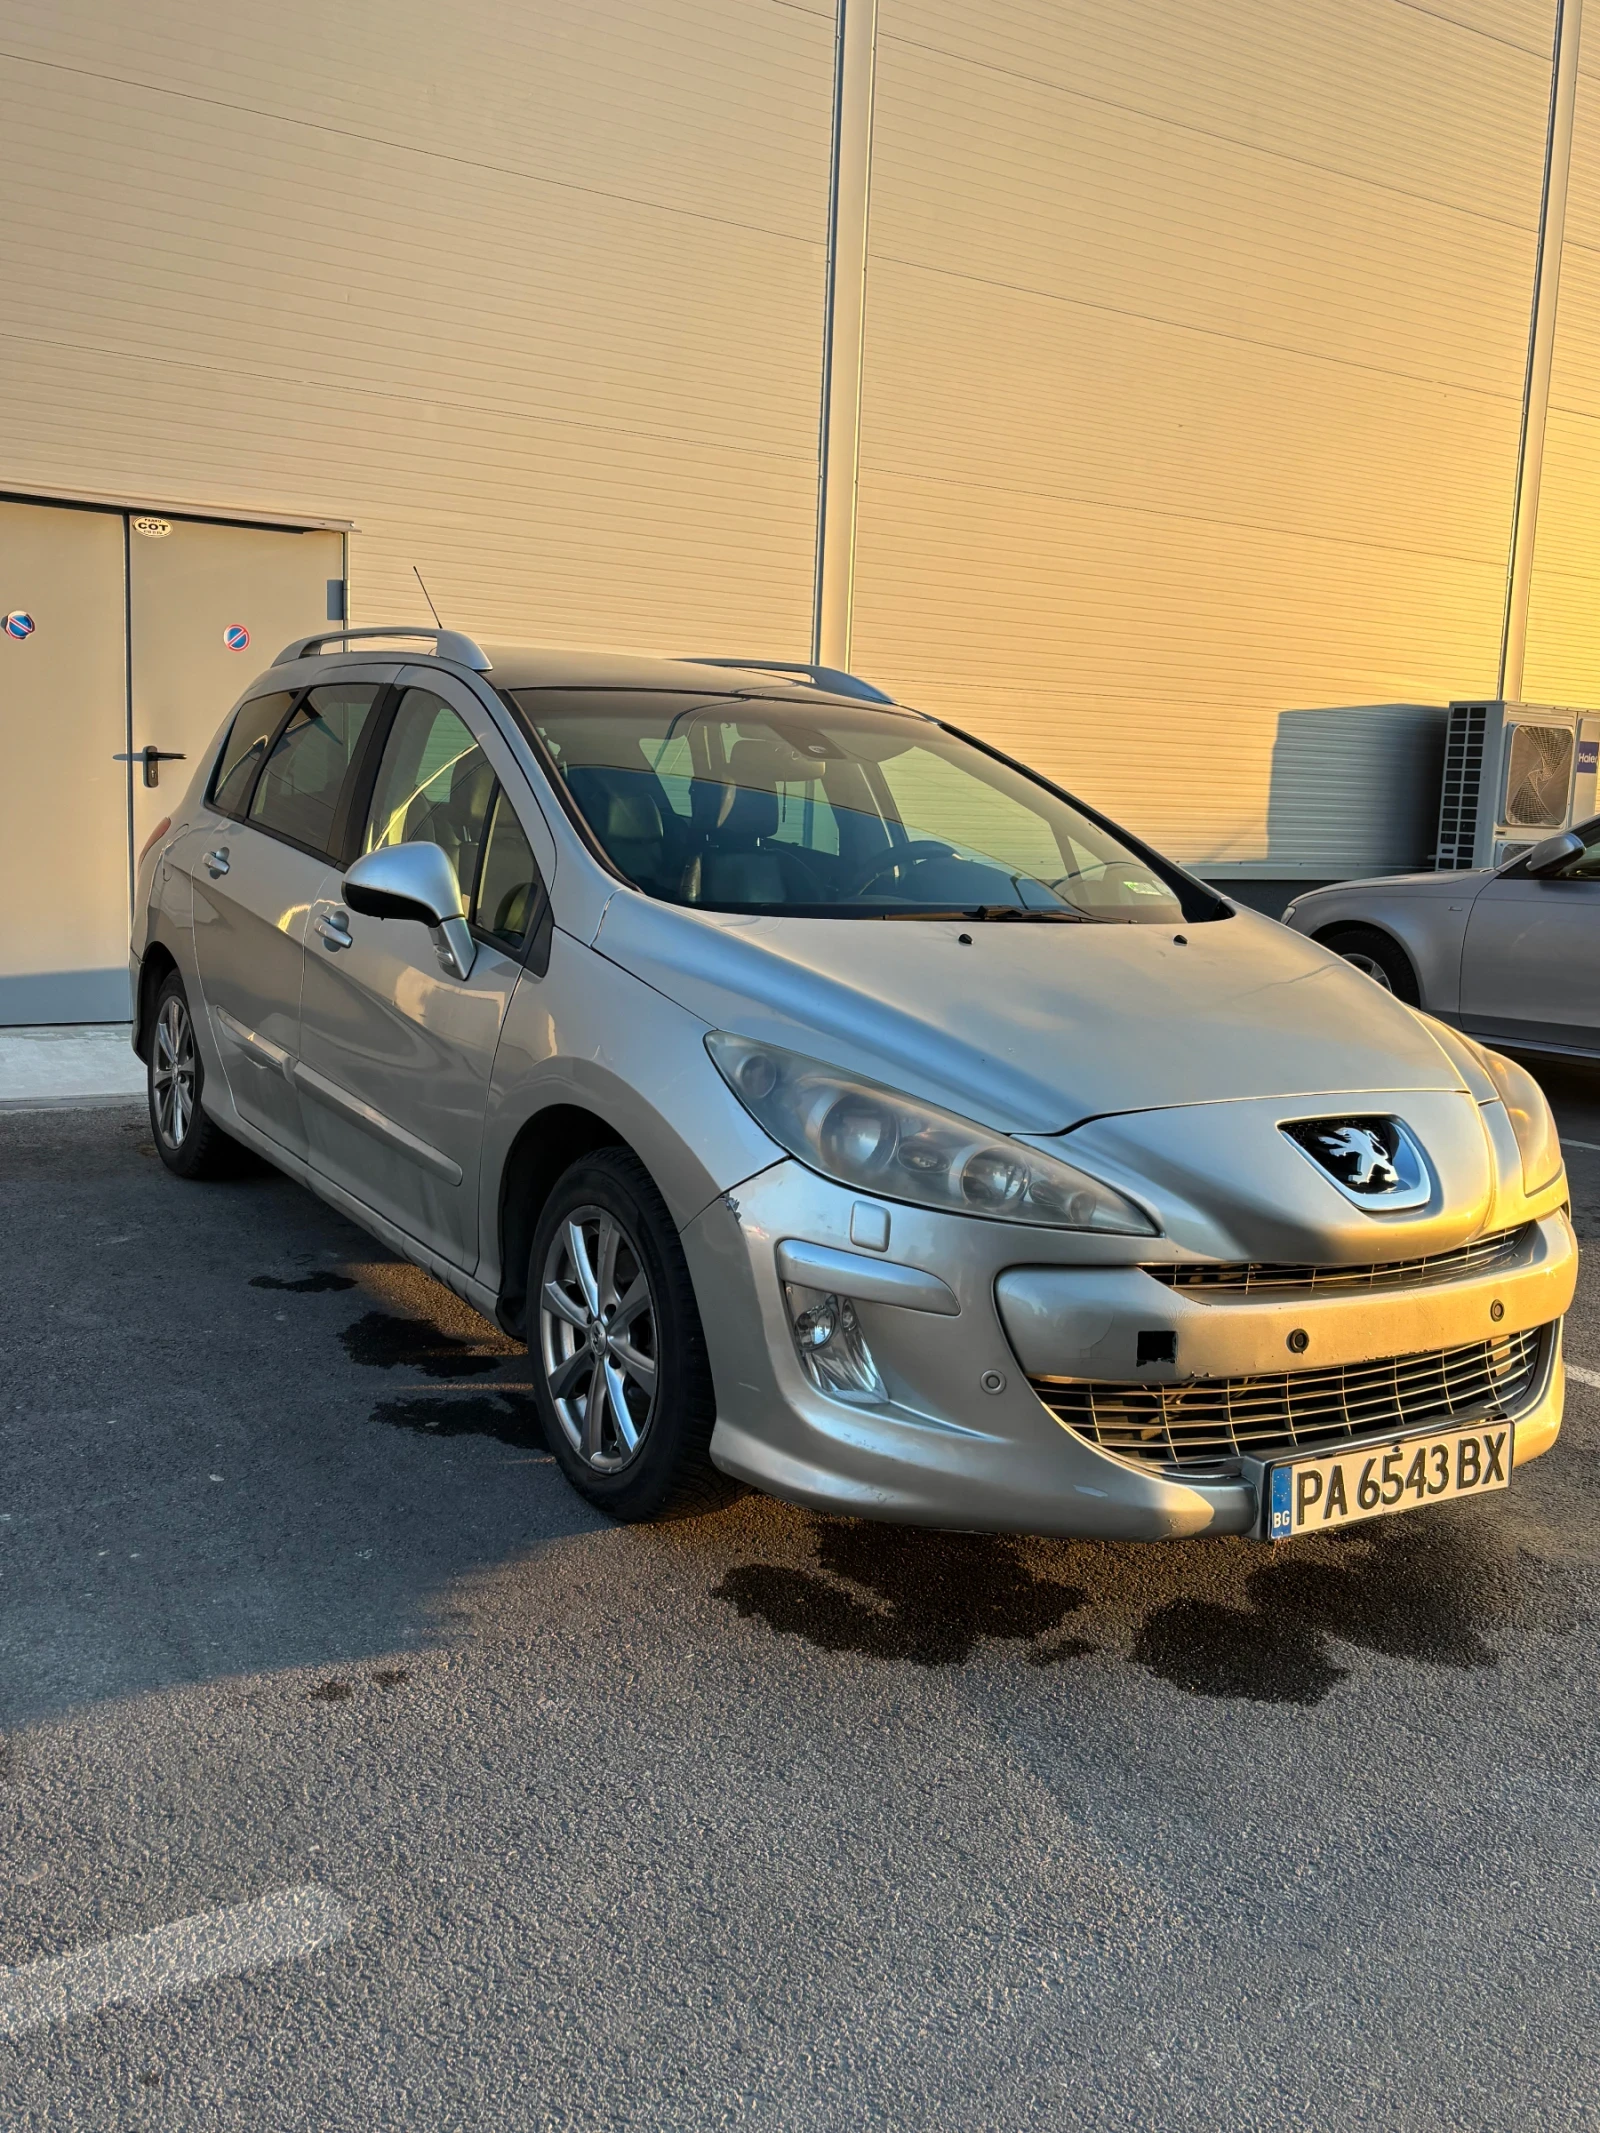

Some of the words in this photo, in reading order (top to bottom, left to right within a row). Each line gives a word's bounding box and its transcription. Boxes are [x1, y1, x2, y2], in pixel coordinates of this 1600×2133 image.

[1578, 752, 1597, 763] Haier
[1296, 1464, 1348, 1526] PA
[1357, 1444, 1449, 1510] 6543
[1456, 1431, 1507, 1490] BX
[1273, 1510, 1290, 1528] BG
